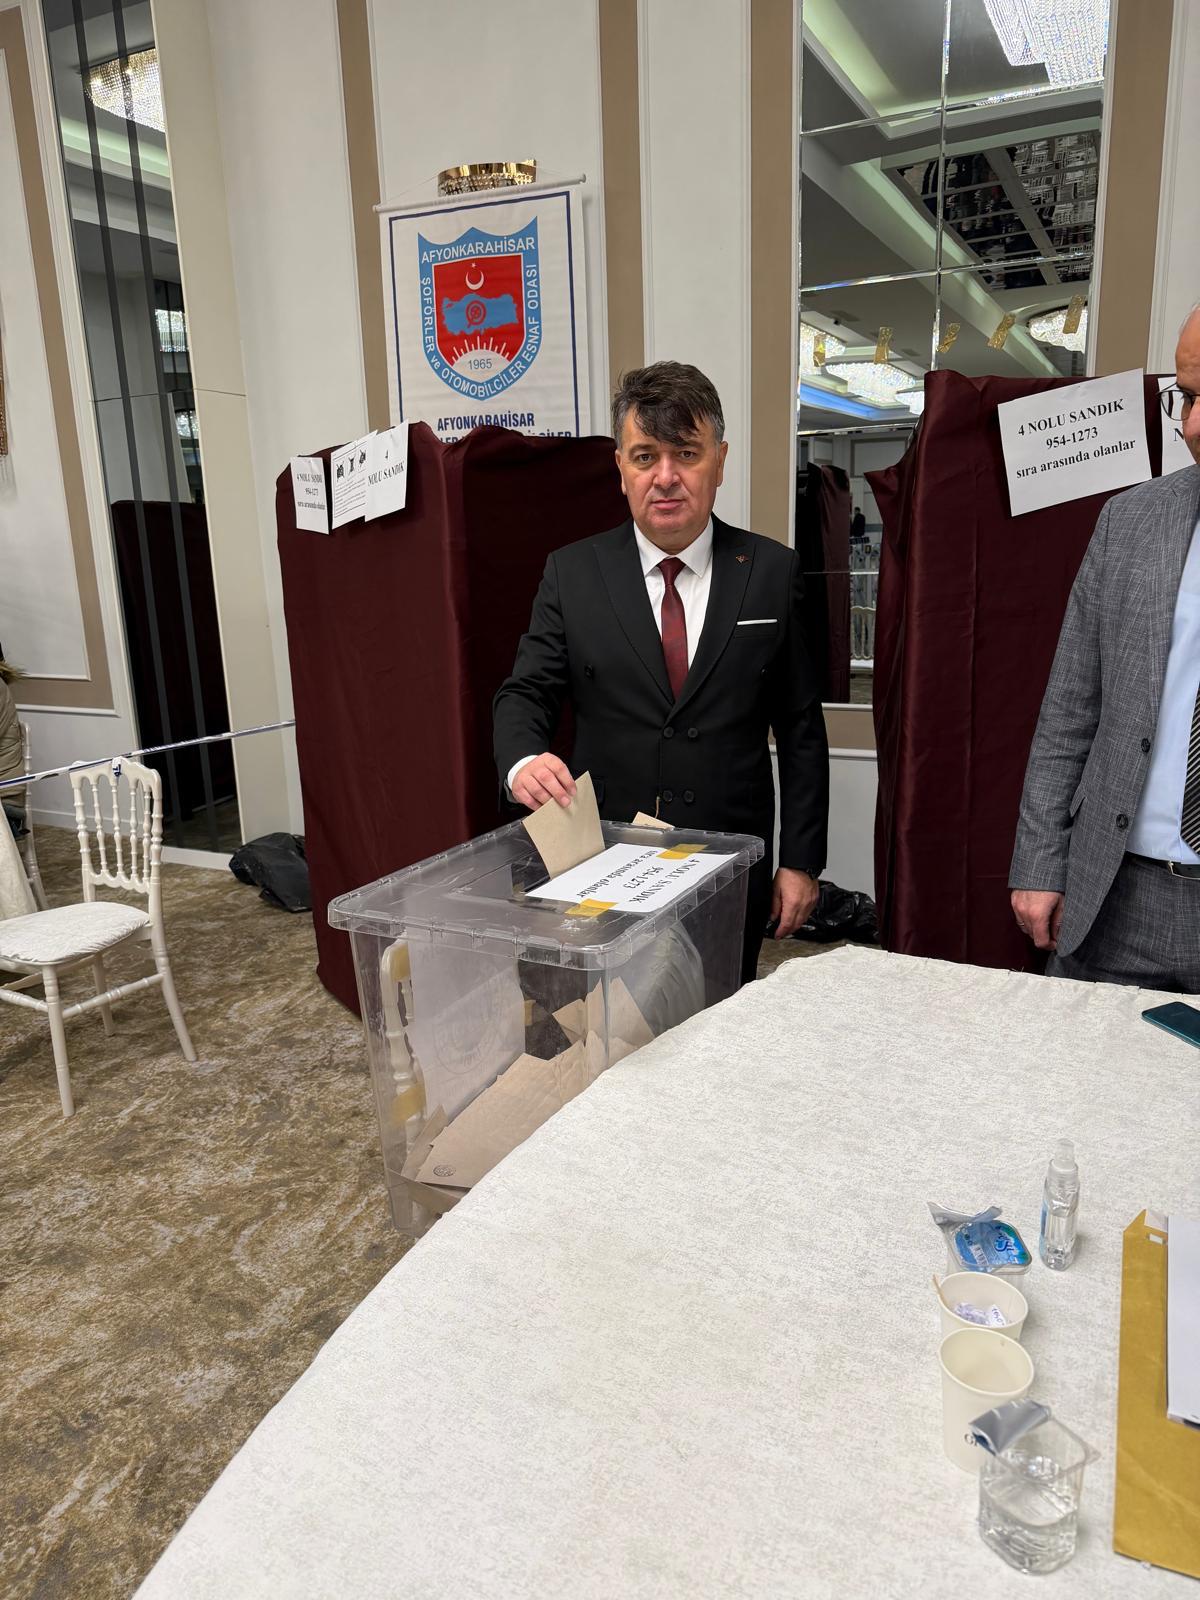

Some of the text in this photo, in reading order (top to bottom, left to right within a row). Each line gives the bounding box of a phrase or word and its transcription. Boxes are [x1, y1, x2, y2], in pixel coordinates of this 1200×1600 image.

[421, 236, 536, 264] AFYONKARAHİSAR
[421, 264, 540, 398] ŞOFÖRLER ve OTOMOBİLCİLER ESNAF ODASI
[468, 358, 493, 370] 1965
[437, 410, 535, 431] AFYONKARAHİSAR
[1018, 398, 1124, 436] 4 NOLU SANDIK
[1046, 426, 1098, 450] 954-1273
[1016, 440, 1136, 479] sıra arasında olanlar
